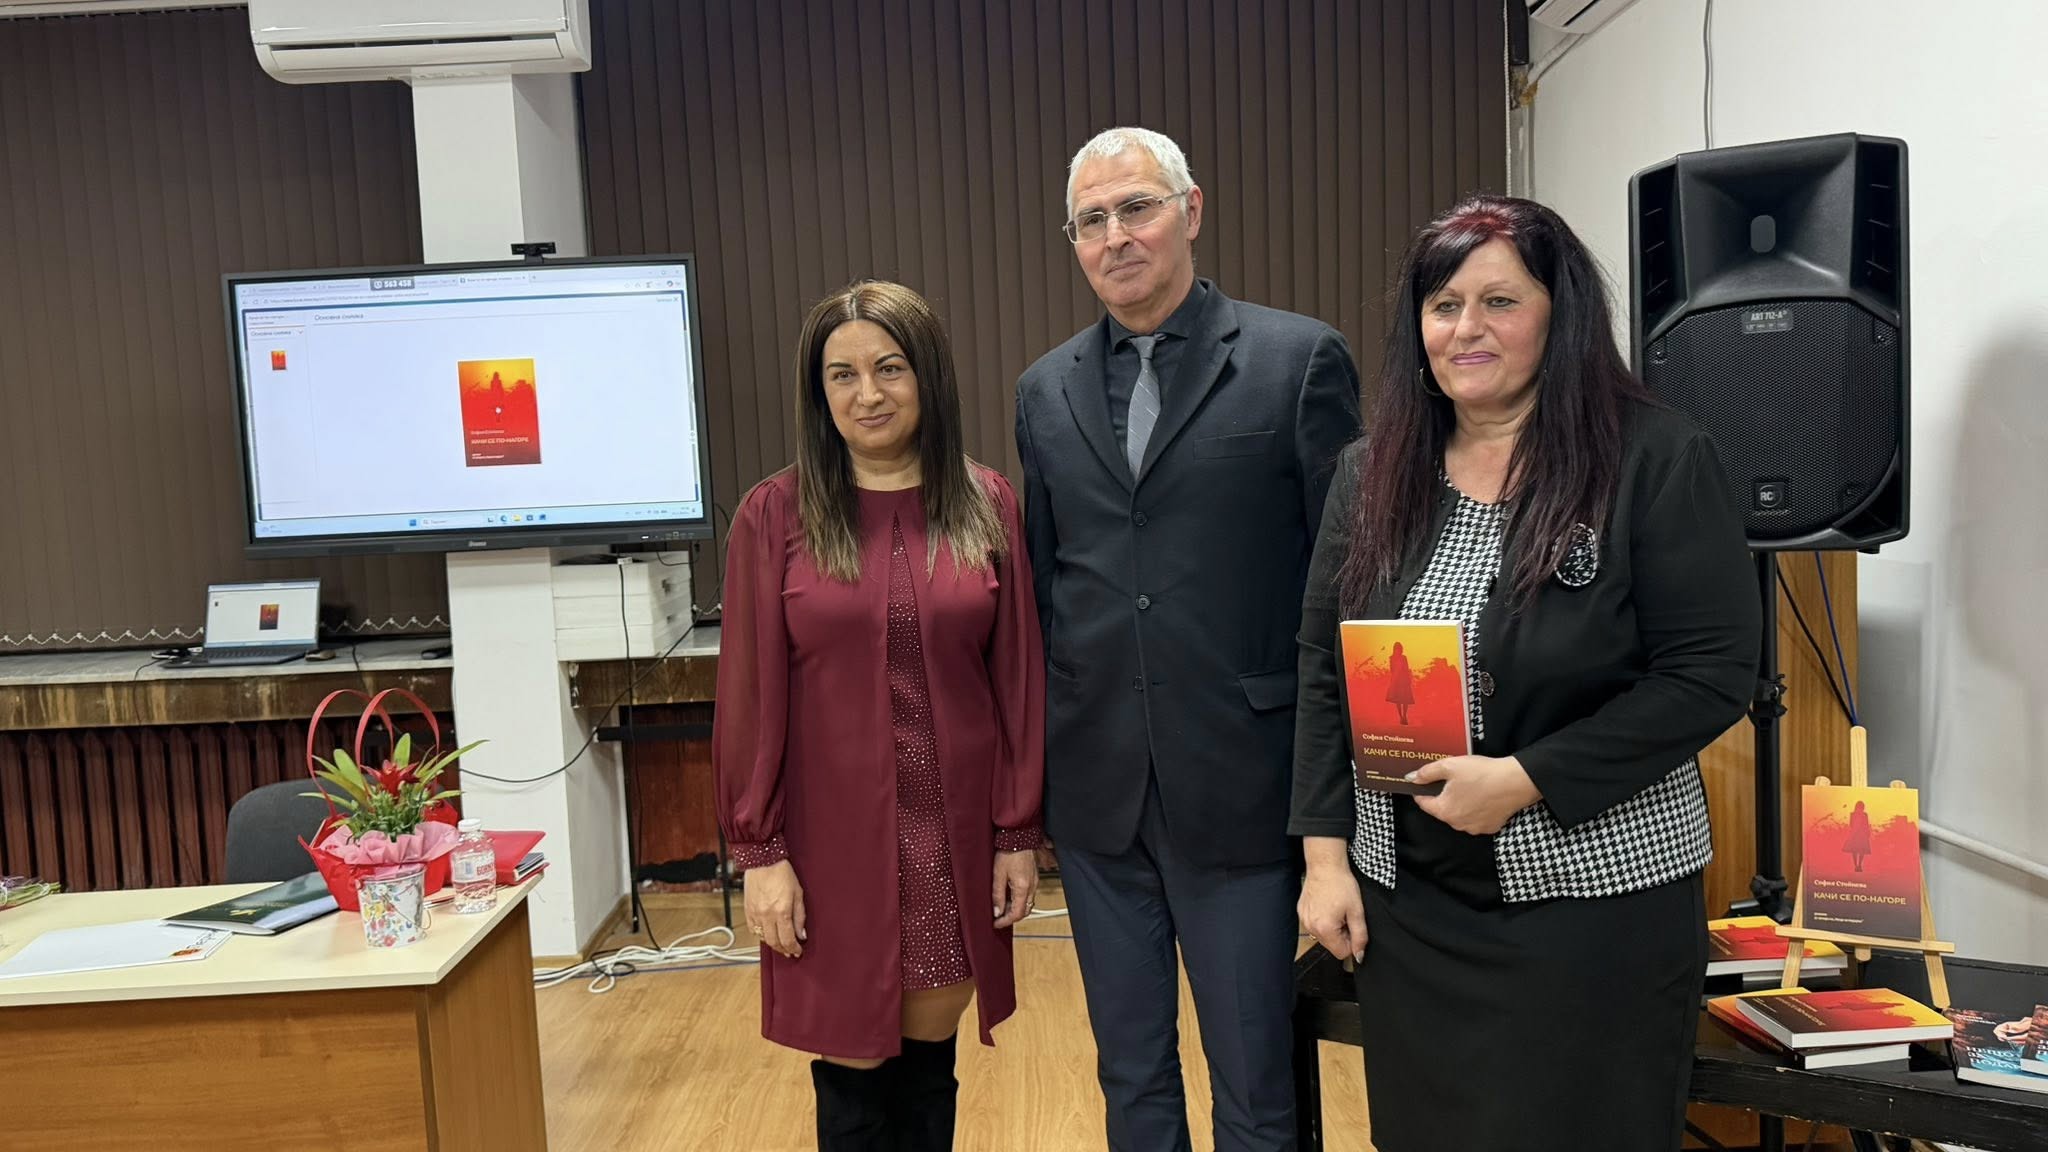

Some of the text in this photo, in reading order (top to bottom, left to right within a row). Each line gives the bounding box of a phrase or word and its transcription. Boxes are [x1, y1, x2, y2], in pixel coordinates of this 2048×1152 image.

[1751, 312, 1764, 321] ART
[1362, 733, 1383, 741] София
[1363, 747, 1452, 761] КАЧИ СЕ ПО-НАГОР
[1813, 879, 1835, 887] София
[1813, 892, 1907, 905] КАЧИ СЕ ПО-НАГОРЕ
